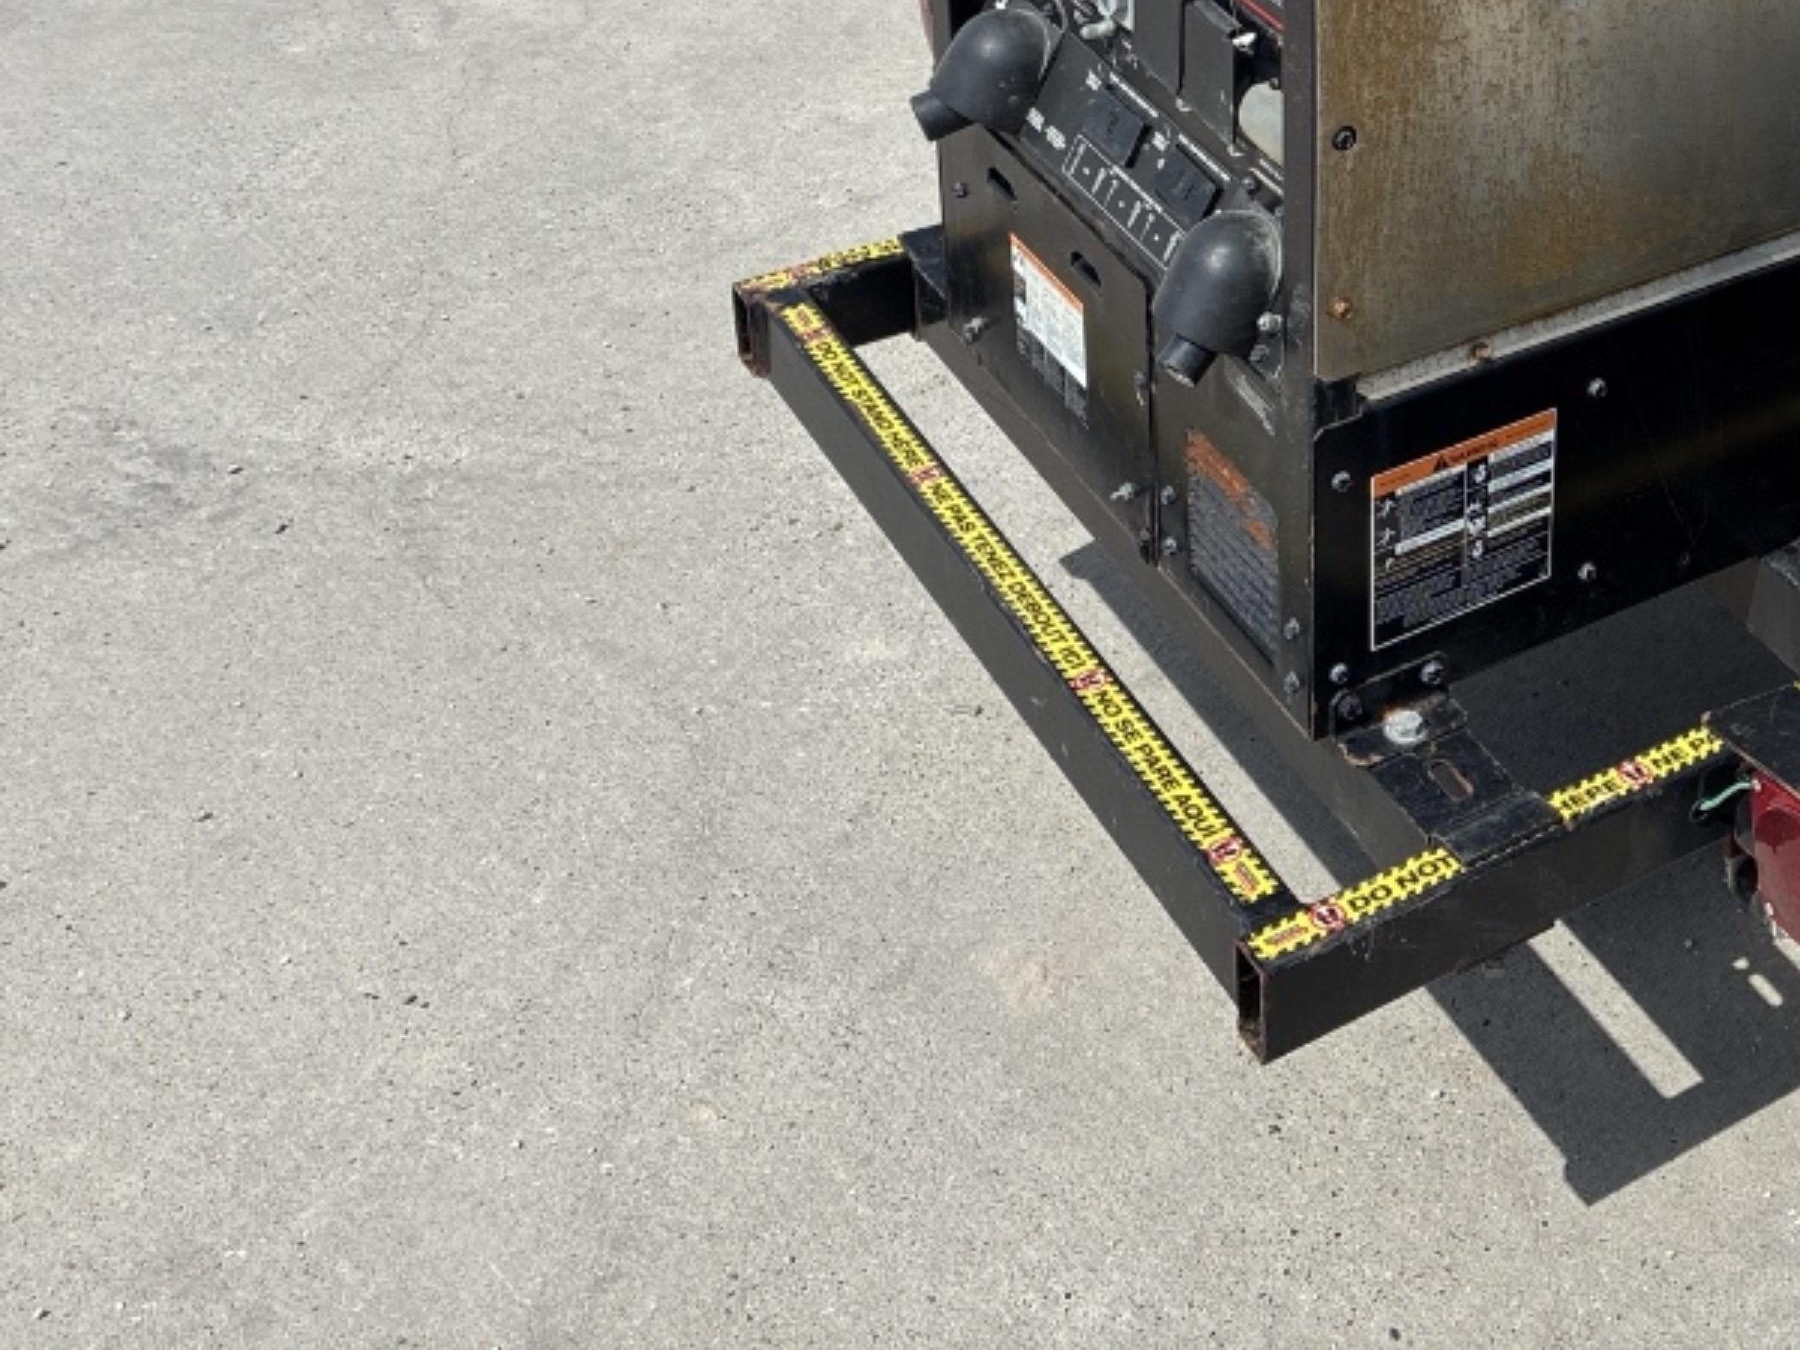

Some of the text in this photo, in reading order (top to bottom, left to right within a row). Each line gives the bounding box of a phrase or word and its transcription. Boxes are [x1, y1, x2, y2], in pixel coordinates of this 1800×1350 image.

[816, 341, 838, 361] DO
[850, 388, 895, 431] STAND
[944, 504, 977, 534] PAS
[971, 534, 1016, 582] TENEZ
[1007, 580, 1070, 645] DEBOUT
[1061, 647, 1088, 671] ICI
[1092, 688, 1123, 718] NO
[1114, 718, 1145, 743] SE
[1133, 742, 1184, 793] PARE
[1349, 856, 1453, 910] DO NOT
